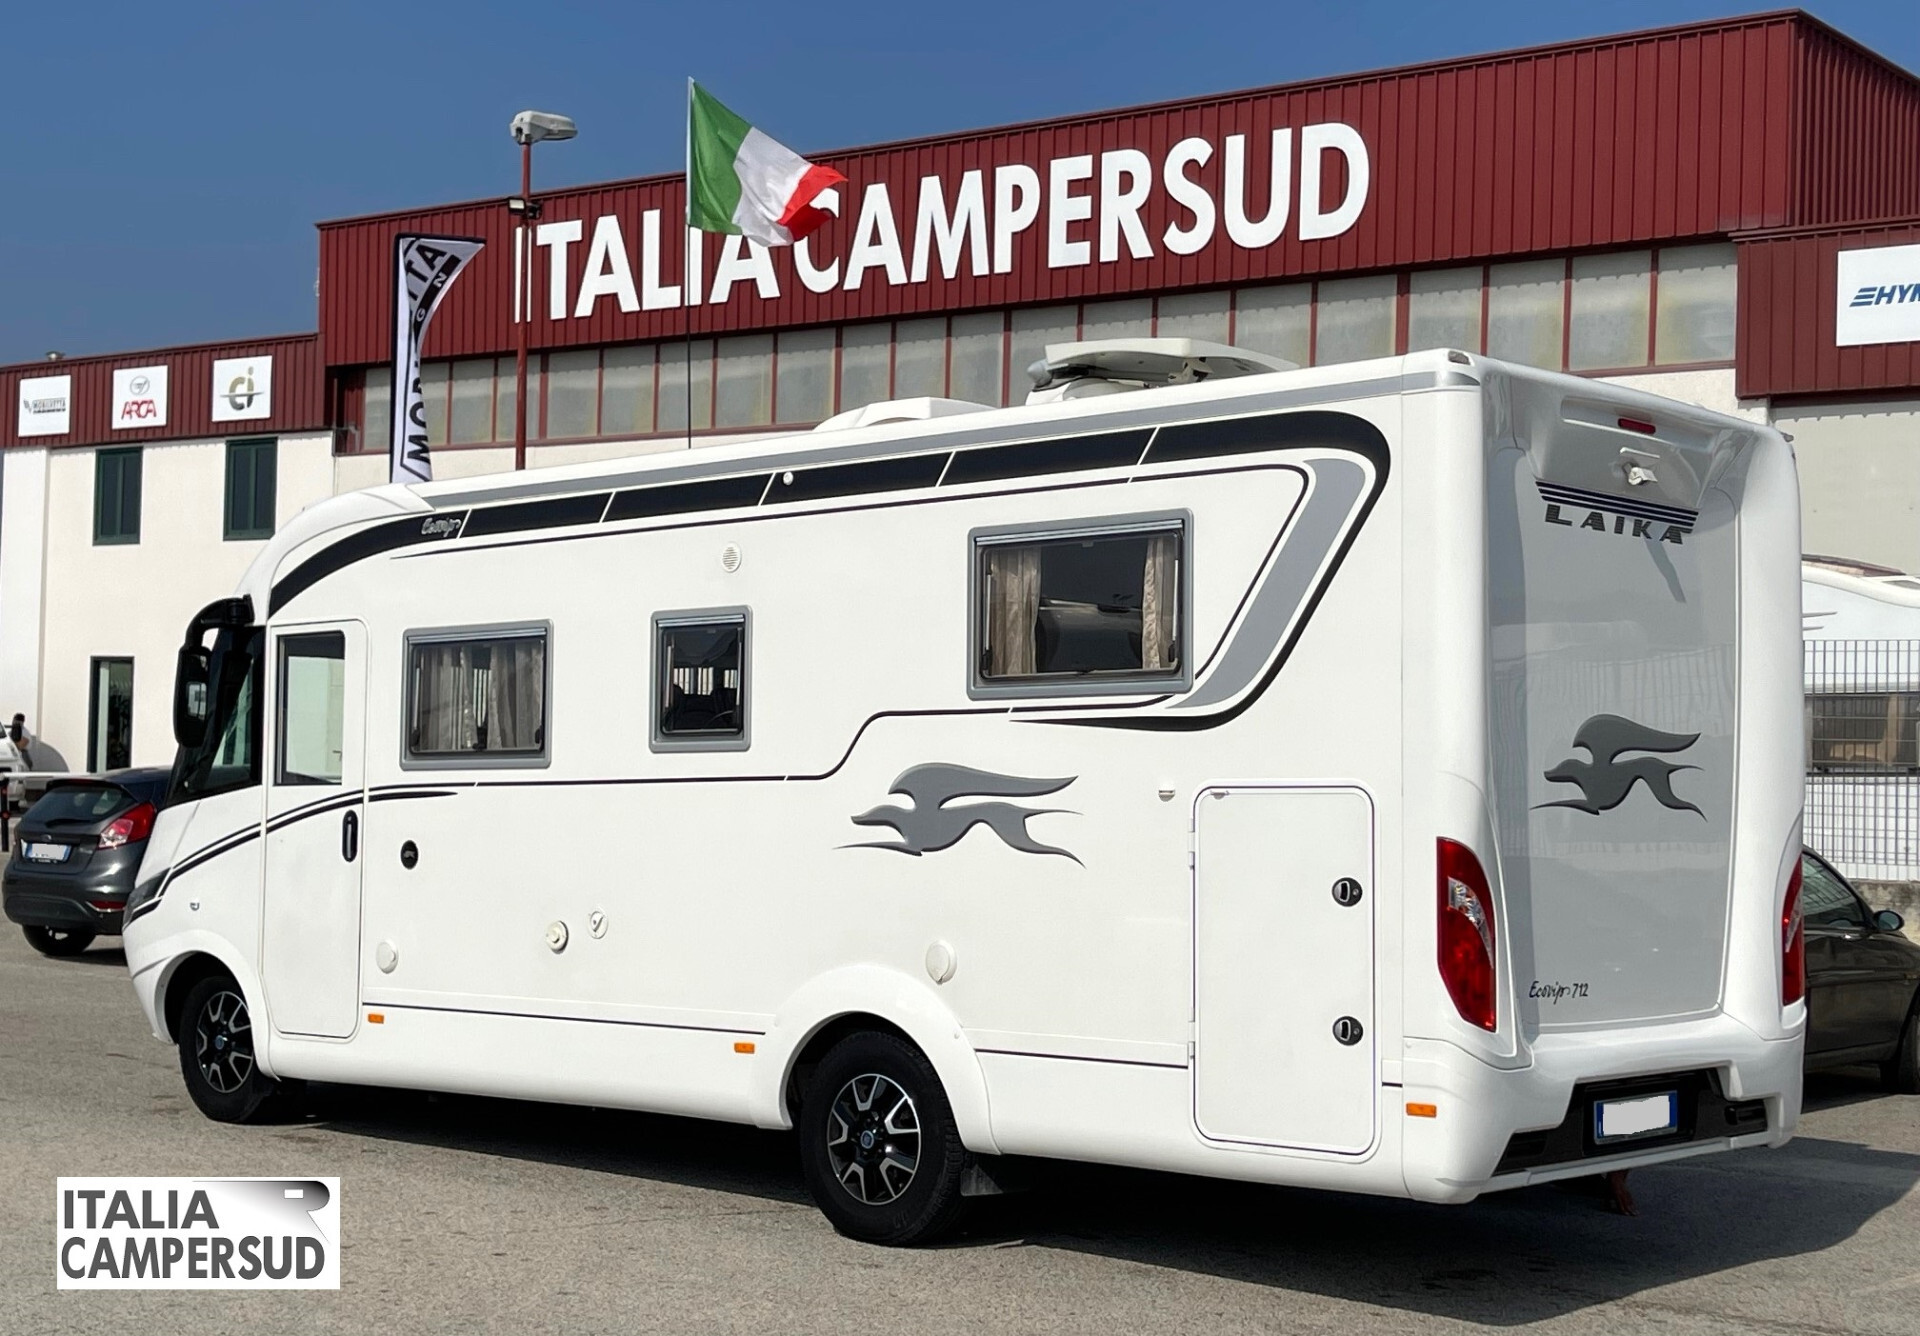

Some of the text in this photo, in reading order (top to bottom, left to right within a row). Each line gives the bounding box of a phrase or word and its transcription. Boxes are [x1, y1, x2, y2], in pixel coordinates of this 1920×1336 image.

[515, 122, 1370, 324] ITALIA CAMPERSUD
[121, 399, 157, 420] ARCA
[1545, 503, 1694, 546] LAIKA
[1571, 982, 1589, 999] 712
